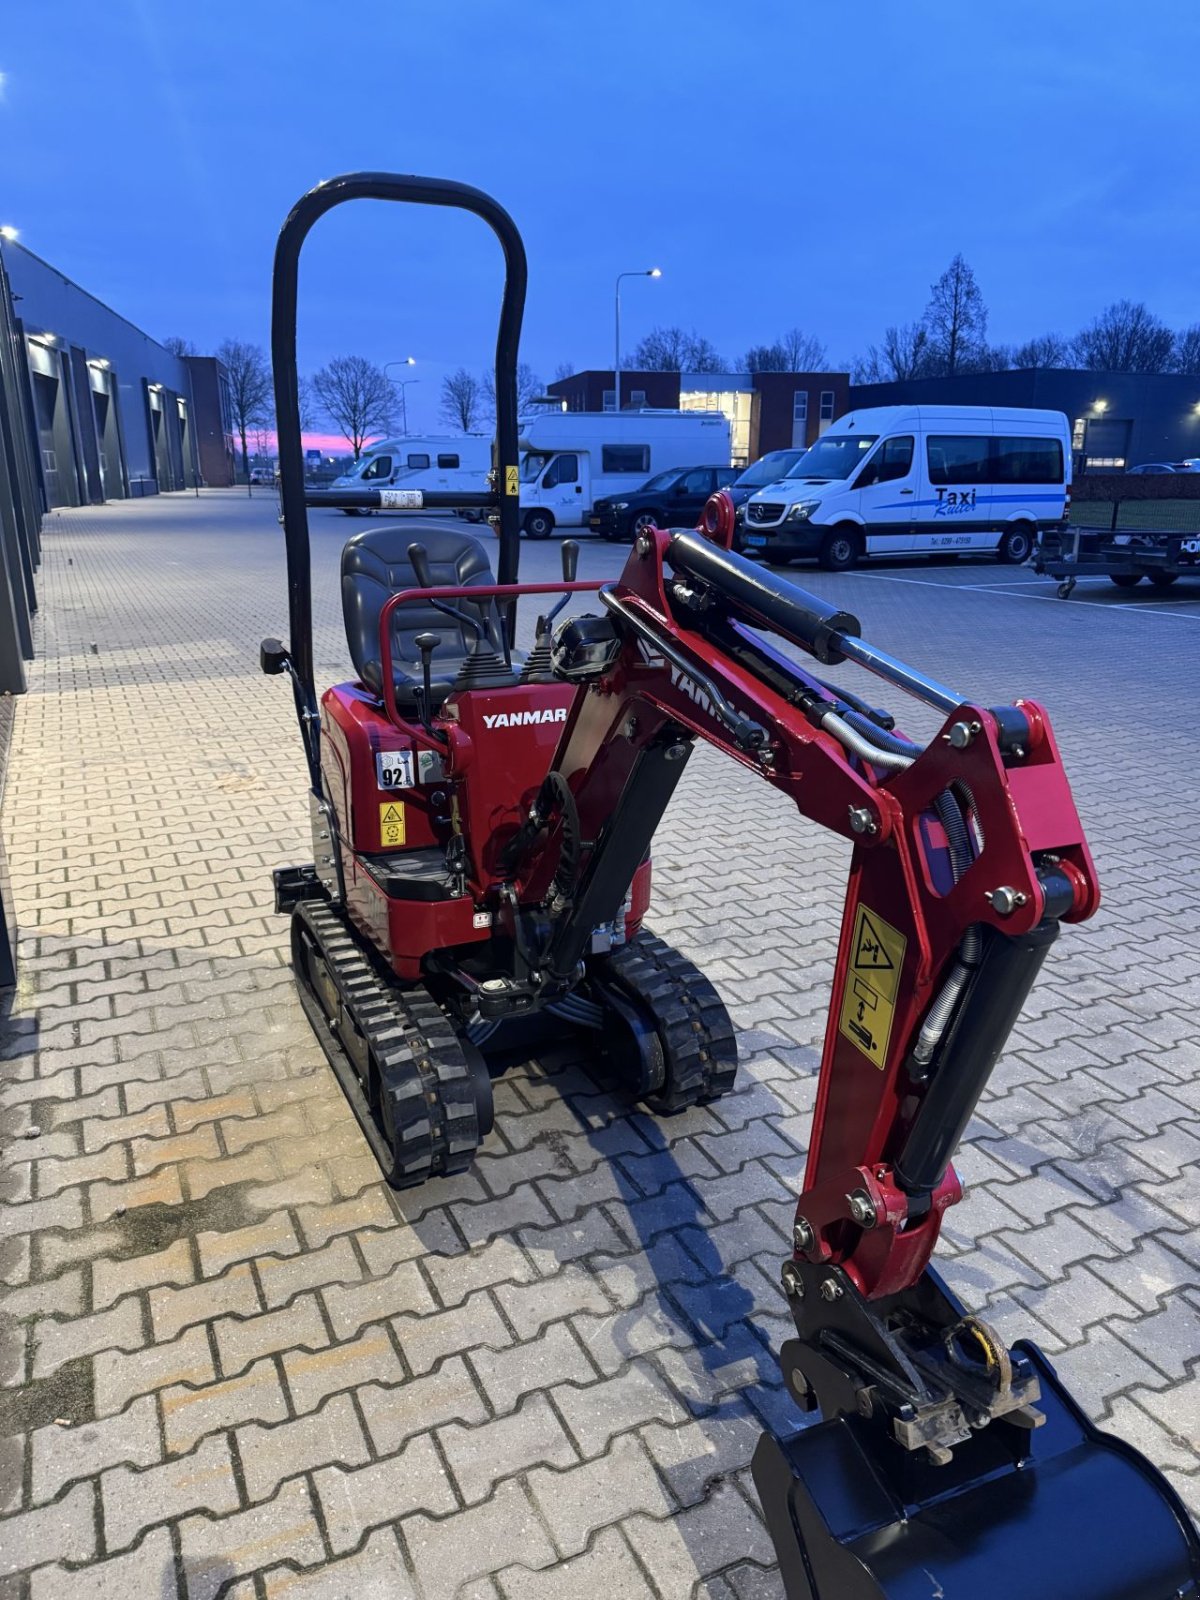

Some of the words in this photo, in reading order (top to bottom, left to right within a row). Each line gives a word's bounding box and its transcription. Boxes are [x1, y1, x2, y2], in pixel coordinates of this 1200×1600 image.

[935, 487, 976, 505] Taxi
[482, 708, 567, 729] YANMAR
[383, 768, 402, 786] 92
